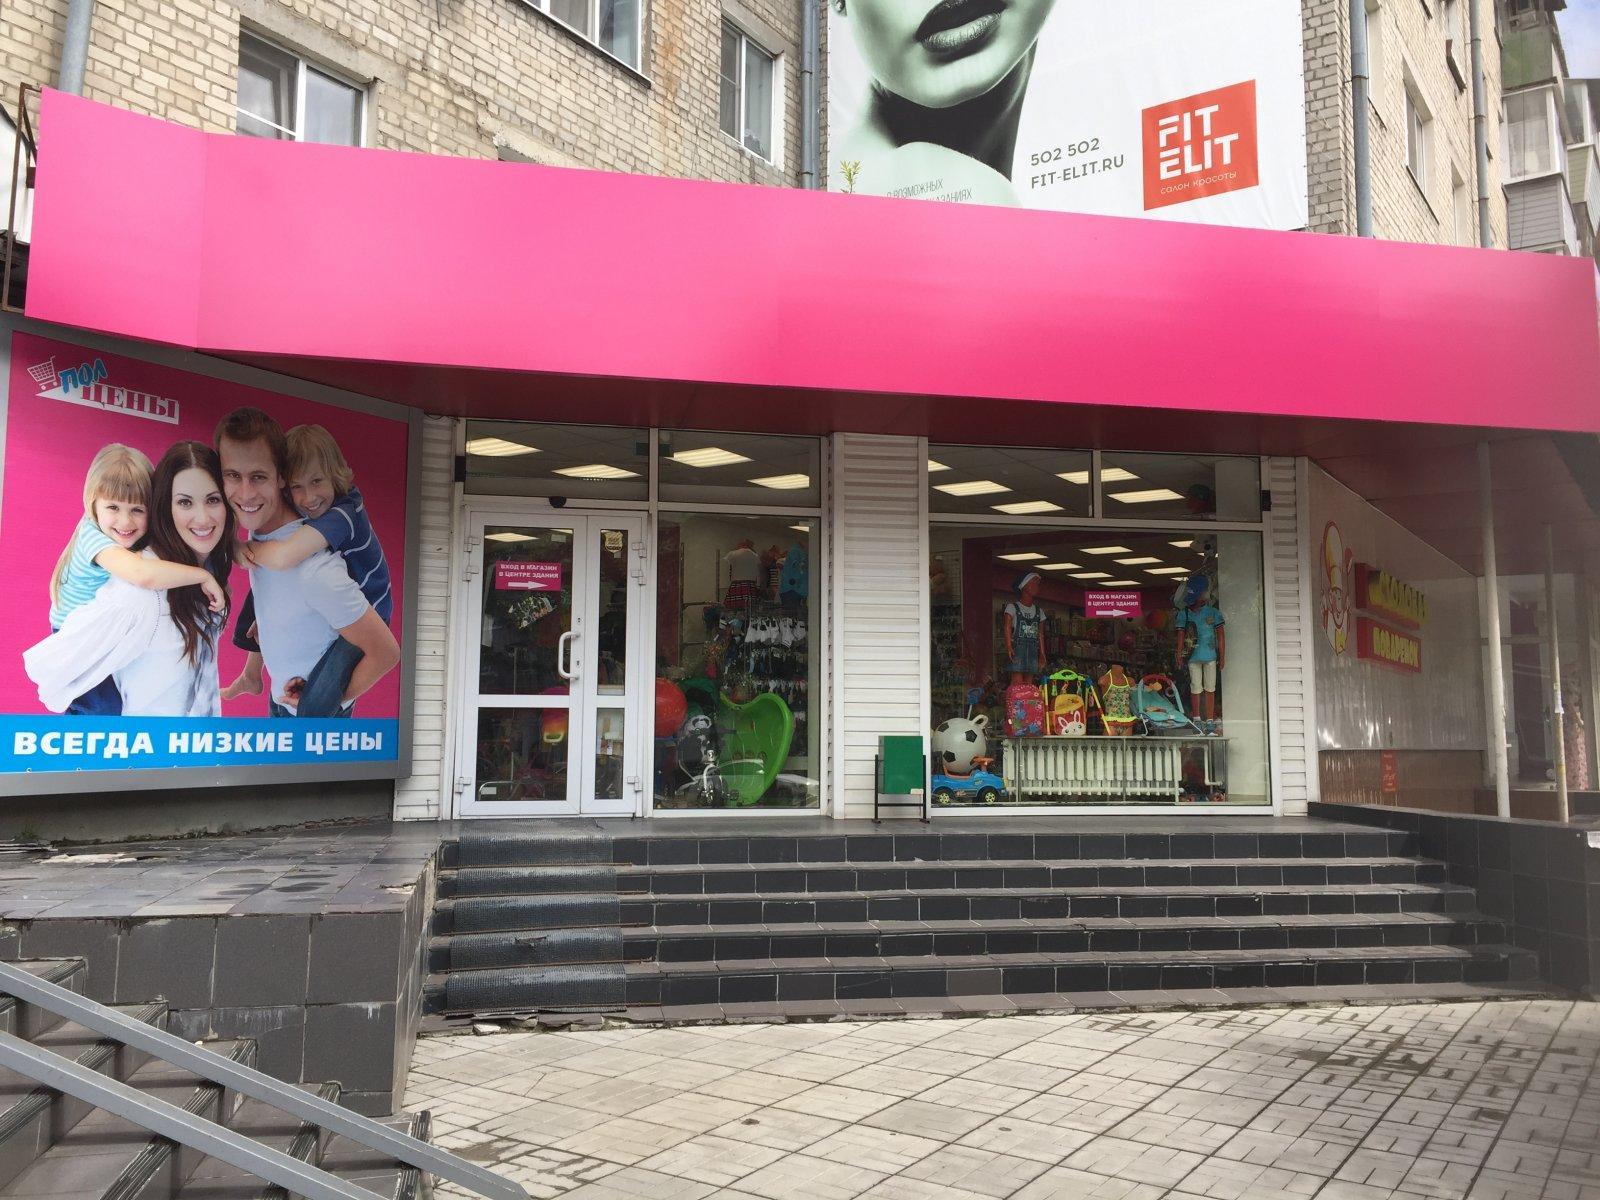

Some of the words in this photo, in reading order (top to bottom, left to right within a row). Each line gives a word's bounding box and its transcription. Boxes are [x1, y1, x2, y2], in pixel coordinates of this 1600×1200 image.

[1158, 104, 1219, 148] FIT
[1030, 147, 1062, 167] 502
[1067, 137, 1100, 157] 502
[1159, 132, 1240, 181] ELIT
[1031, 154, 1124, 189] FIT-ELIT.RU
[1160, 183, 1190, 195] салон
[1193, 171, 1238, 188] красоты
[58, 358, 109, 394] ПОЛ
[81, 382, 179, 423] ЦЕНЫ
[13, 731, 154, 759] ВСЕГДА
[168, 731, 293, 754] НИЗКИЕ
[305, 730, 383, 755] ЦЕНЫ
